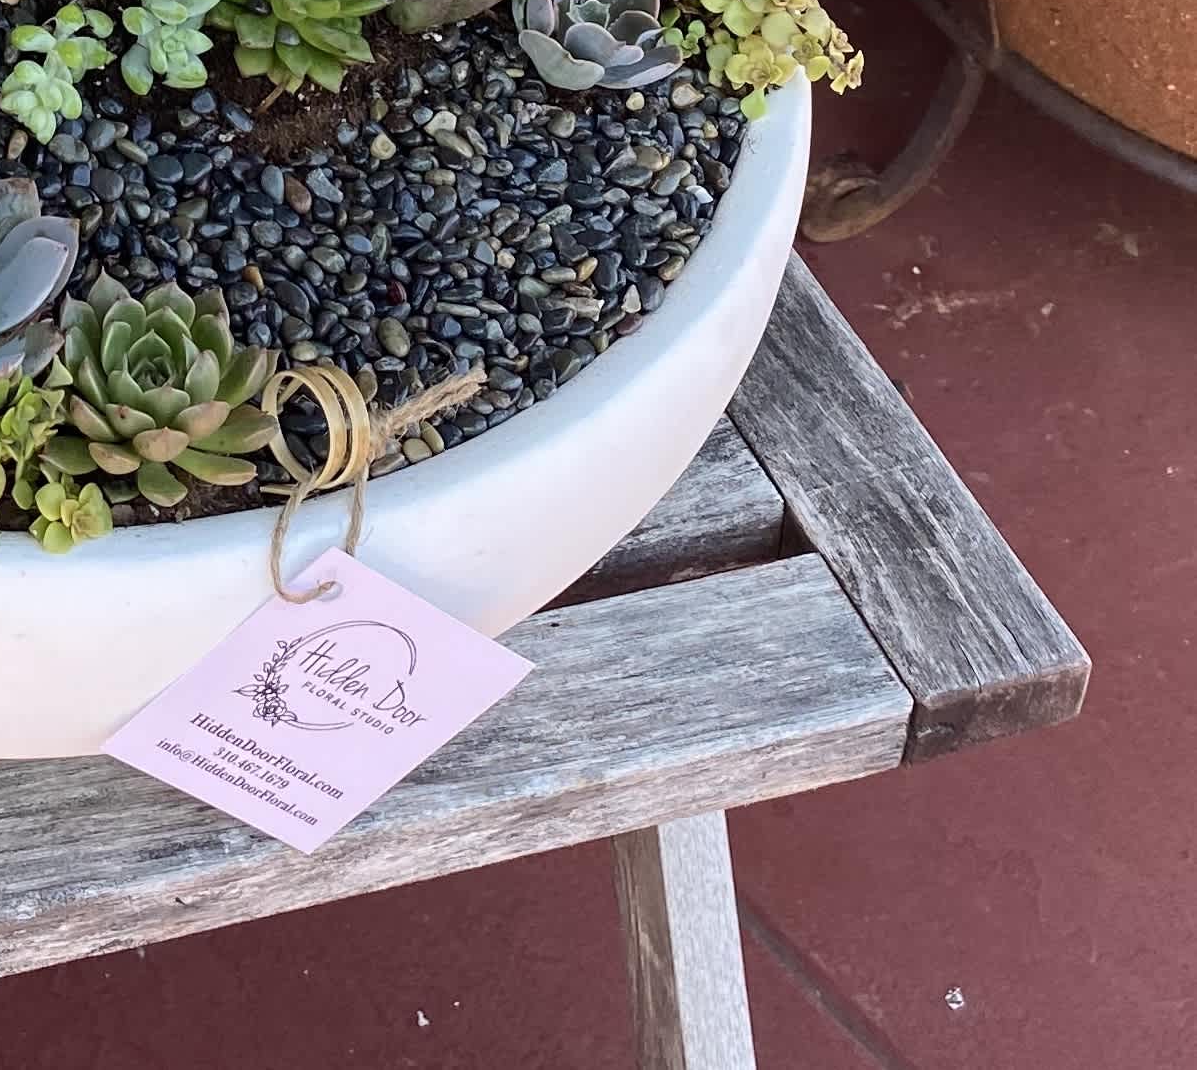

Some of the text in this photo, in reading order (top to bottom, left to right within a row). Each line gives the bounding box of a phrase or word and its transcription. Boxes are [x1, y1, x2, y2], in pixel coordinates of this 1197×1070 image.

[299, 639, 430, 729] Hidden Door
[302, 681, 394, 735] FLORAL STUDIO
[156, 737, 319, 826] info@HiddenDoorFloral.com
[190, 712, 344, 800] HiddenDoorFloral.com
[213, 745, 291, 790] 310.467.1679
